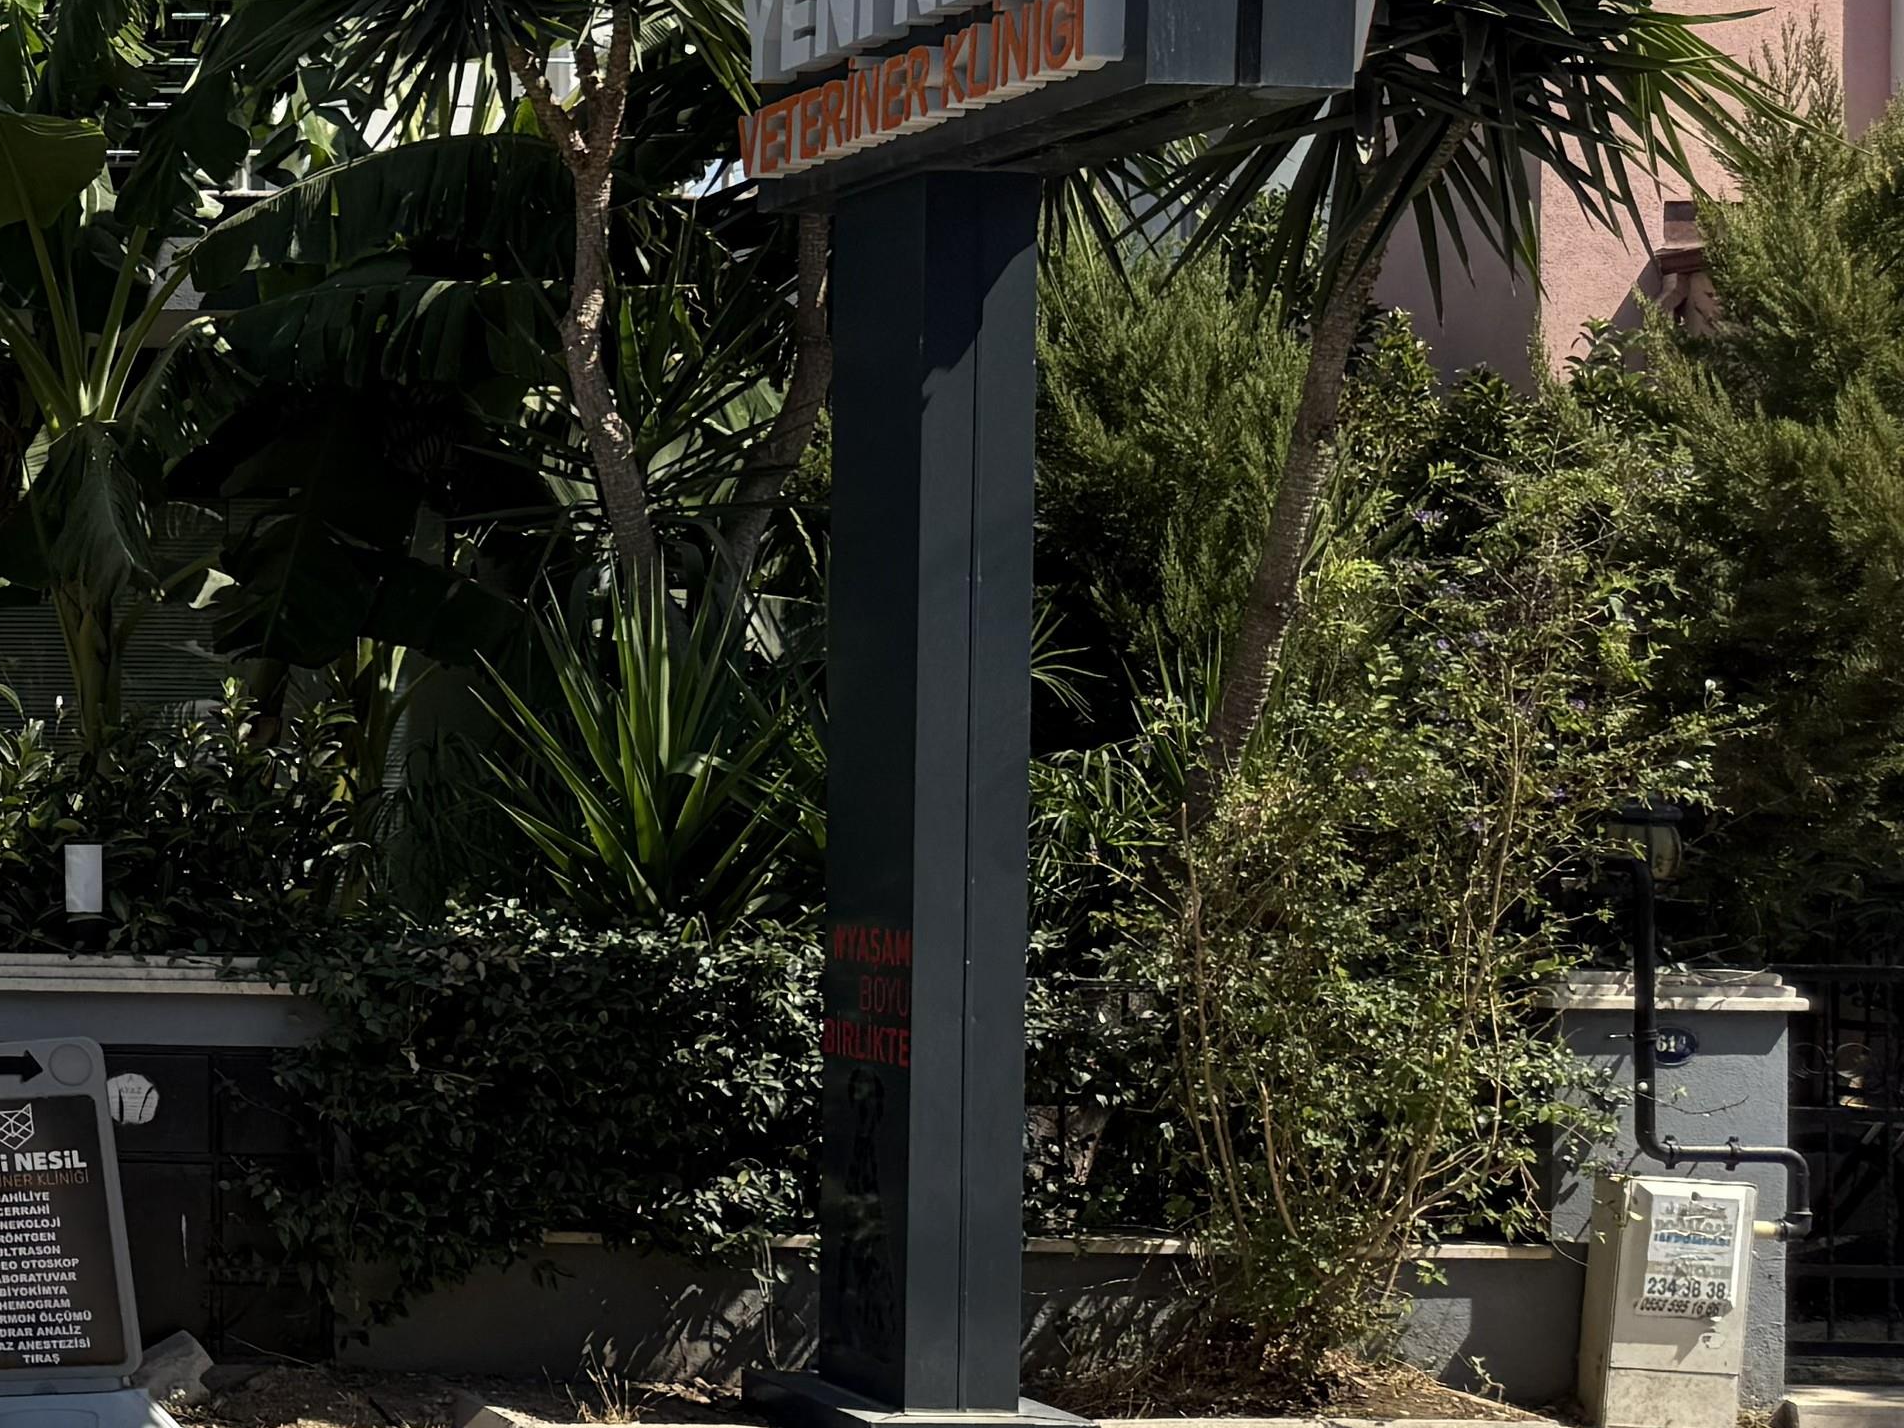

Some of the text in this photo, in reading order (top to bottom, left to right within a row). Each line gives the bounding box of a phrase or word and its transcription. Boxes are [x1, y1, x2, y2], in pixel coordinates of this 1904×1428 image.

[738, 47, 934, 178] VETERİNER
[859, 974, 910, 1018] BOYU
[21, 1258, 79, 1269] OTOSKOP
[1647, 1277, 1677, 1296] 234
[1706, 1282, 1727, 1300] 38
[36, 1324, 82, 1336] ANALİZ
[18, 1337, 90, 1350] ANESTEZİSİ
